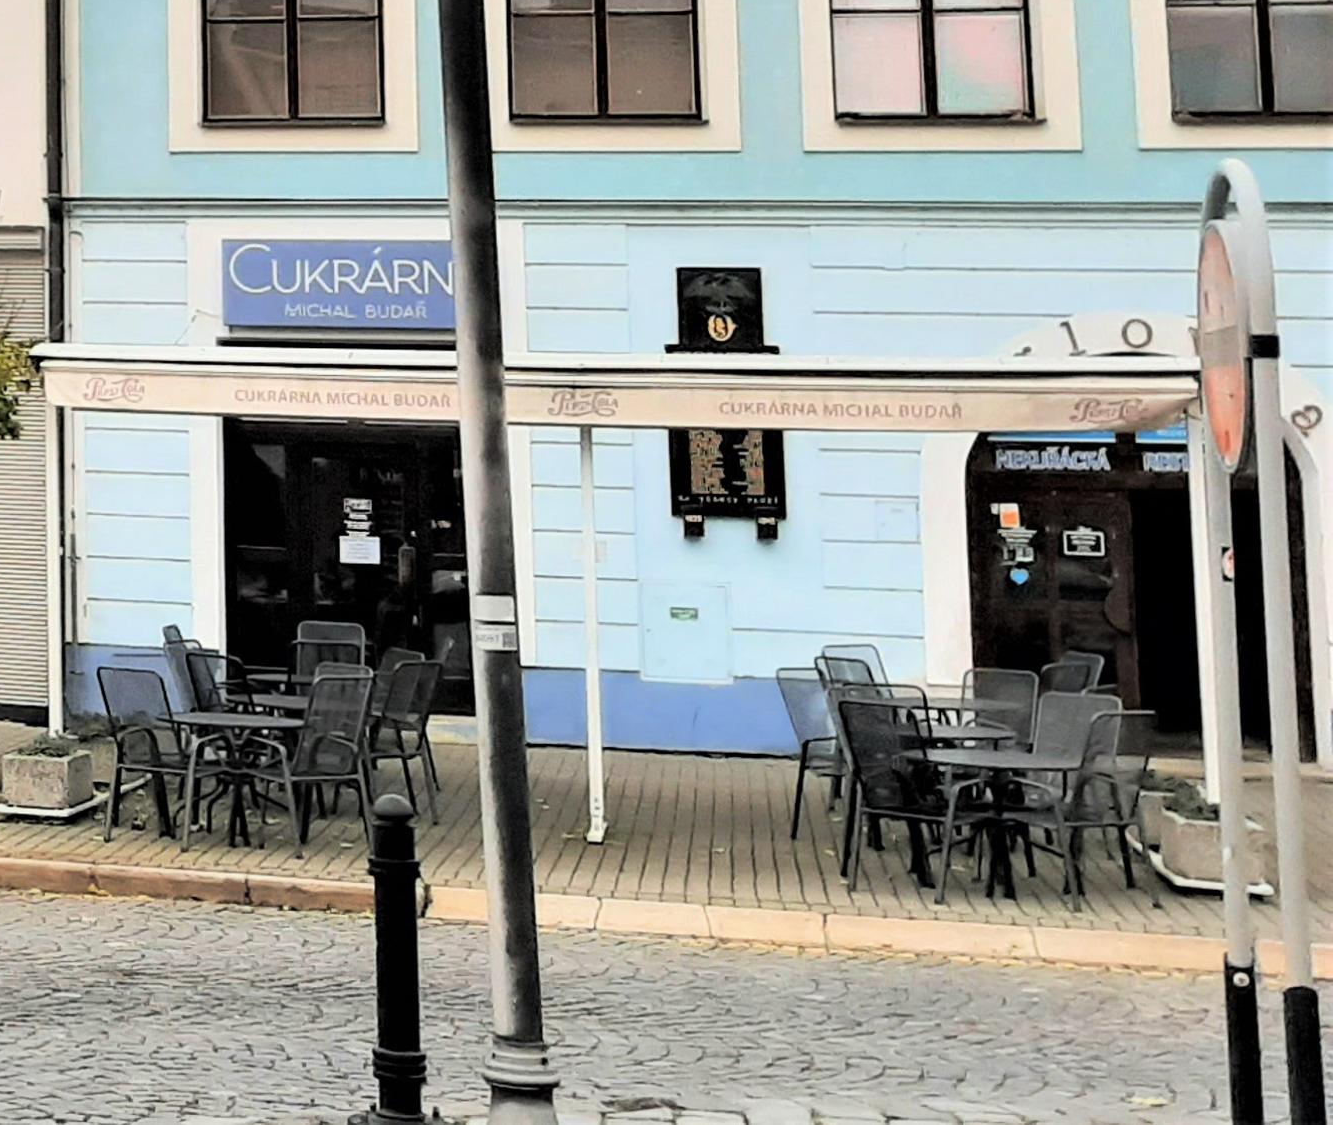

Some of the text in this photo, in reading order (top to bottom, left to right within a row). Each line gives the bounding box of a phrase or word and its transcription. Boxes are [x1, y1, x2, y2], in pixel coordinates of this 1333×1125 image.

[229, 243, 455, 296] CUKRÁRN
[284, 300, 428, 319] MICHAL BUDAŘ
[234, 388, 322, 404] CUKRÁRNA
[326, 391, 389, 406] MICHAL
[718, 400, 818, 416] CUKRÁRNA
[823, 403, 894, 418] MICHAL
